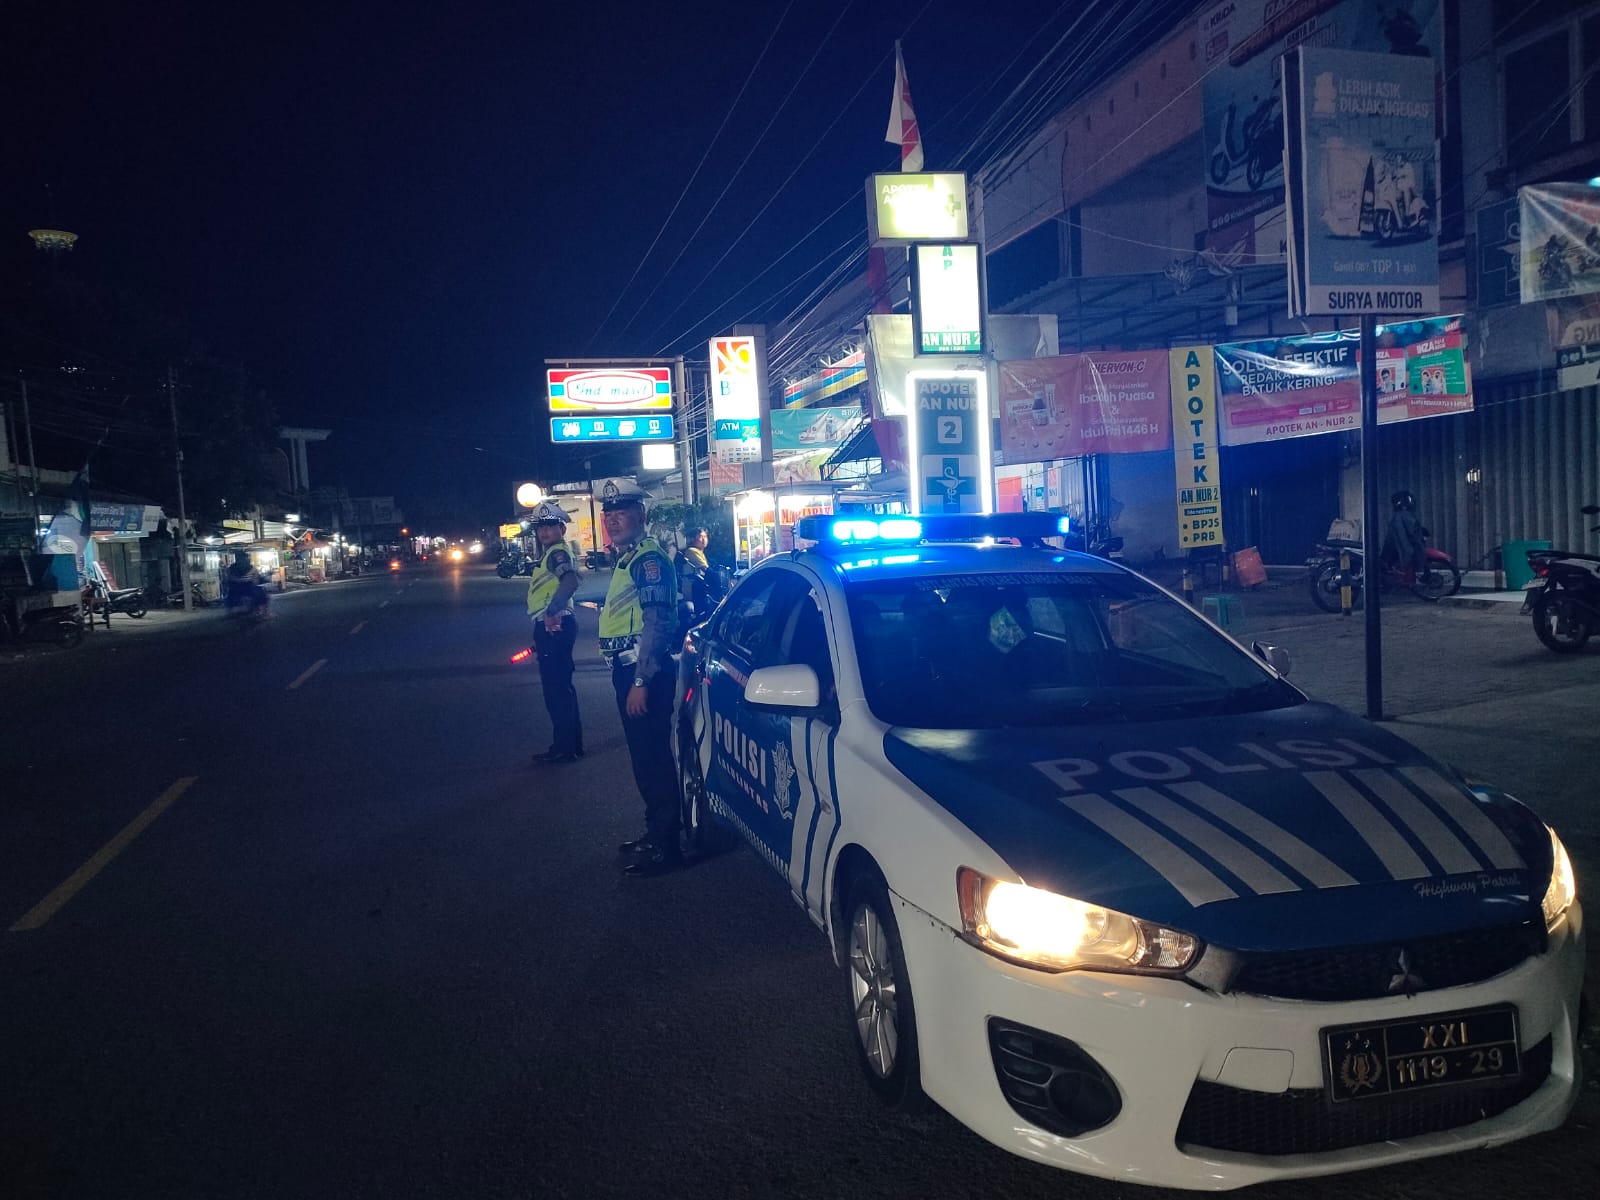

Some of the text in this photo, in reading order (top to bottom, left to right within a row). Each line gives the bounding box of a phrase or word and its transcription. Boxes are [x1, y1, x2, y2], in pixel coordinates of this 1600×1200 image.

[1340, 79, 1400, 98] LEBIH ASIK
[1371, 259, 1392, 273] TOP
[1328, 291, 1423, 309] SURYA MOTOR
[922, 332, 981, 346] AN NUR 2
[919, 383, 977, 395] APOTEK
[1242, 376, 1337, 397] BATUK KERING!
[919, 398, 942, 410] AN
[1118, 391, 1155, 402] Puasa
[1185, 350, 1208, 483] APOTEK
[1266, 422, 1303, 435] APOTEK
[1305, 421, 1318, 432] AN
[1326, 417, 1346, 429] NUR
[1348, 416, 1354, 424] 2
[721, 422, 740, 431] ATM
[943, 421, 957, 439] 2
[1080, 426, 1105, 439] Idul
[1121, 424, 1148, 436] 1446
[1149, 423, 1159, 434] H
[1181, 488, 1219, 503] AN NUR 2
[1193, 518, 1219, 529] BPJS
[1193, 531, 1215, 542] PRB
[715, 711, 767, 788] POLISI
[1030, 738, 1397, 792] POLISI
[1414, 880, 1477, 899] Highway
[1421, 1021, 1469, 1049] XXI
[1396, 1056, 1448, 1084] 1119
[1470, 1047, 1503, 1073] 29
